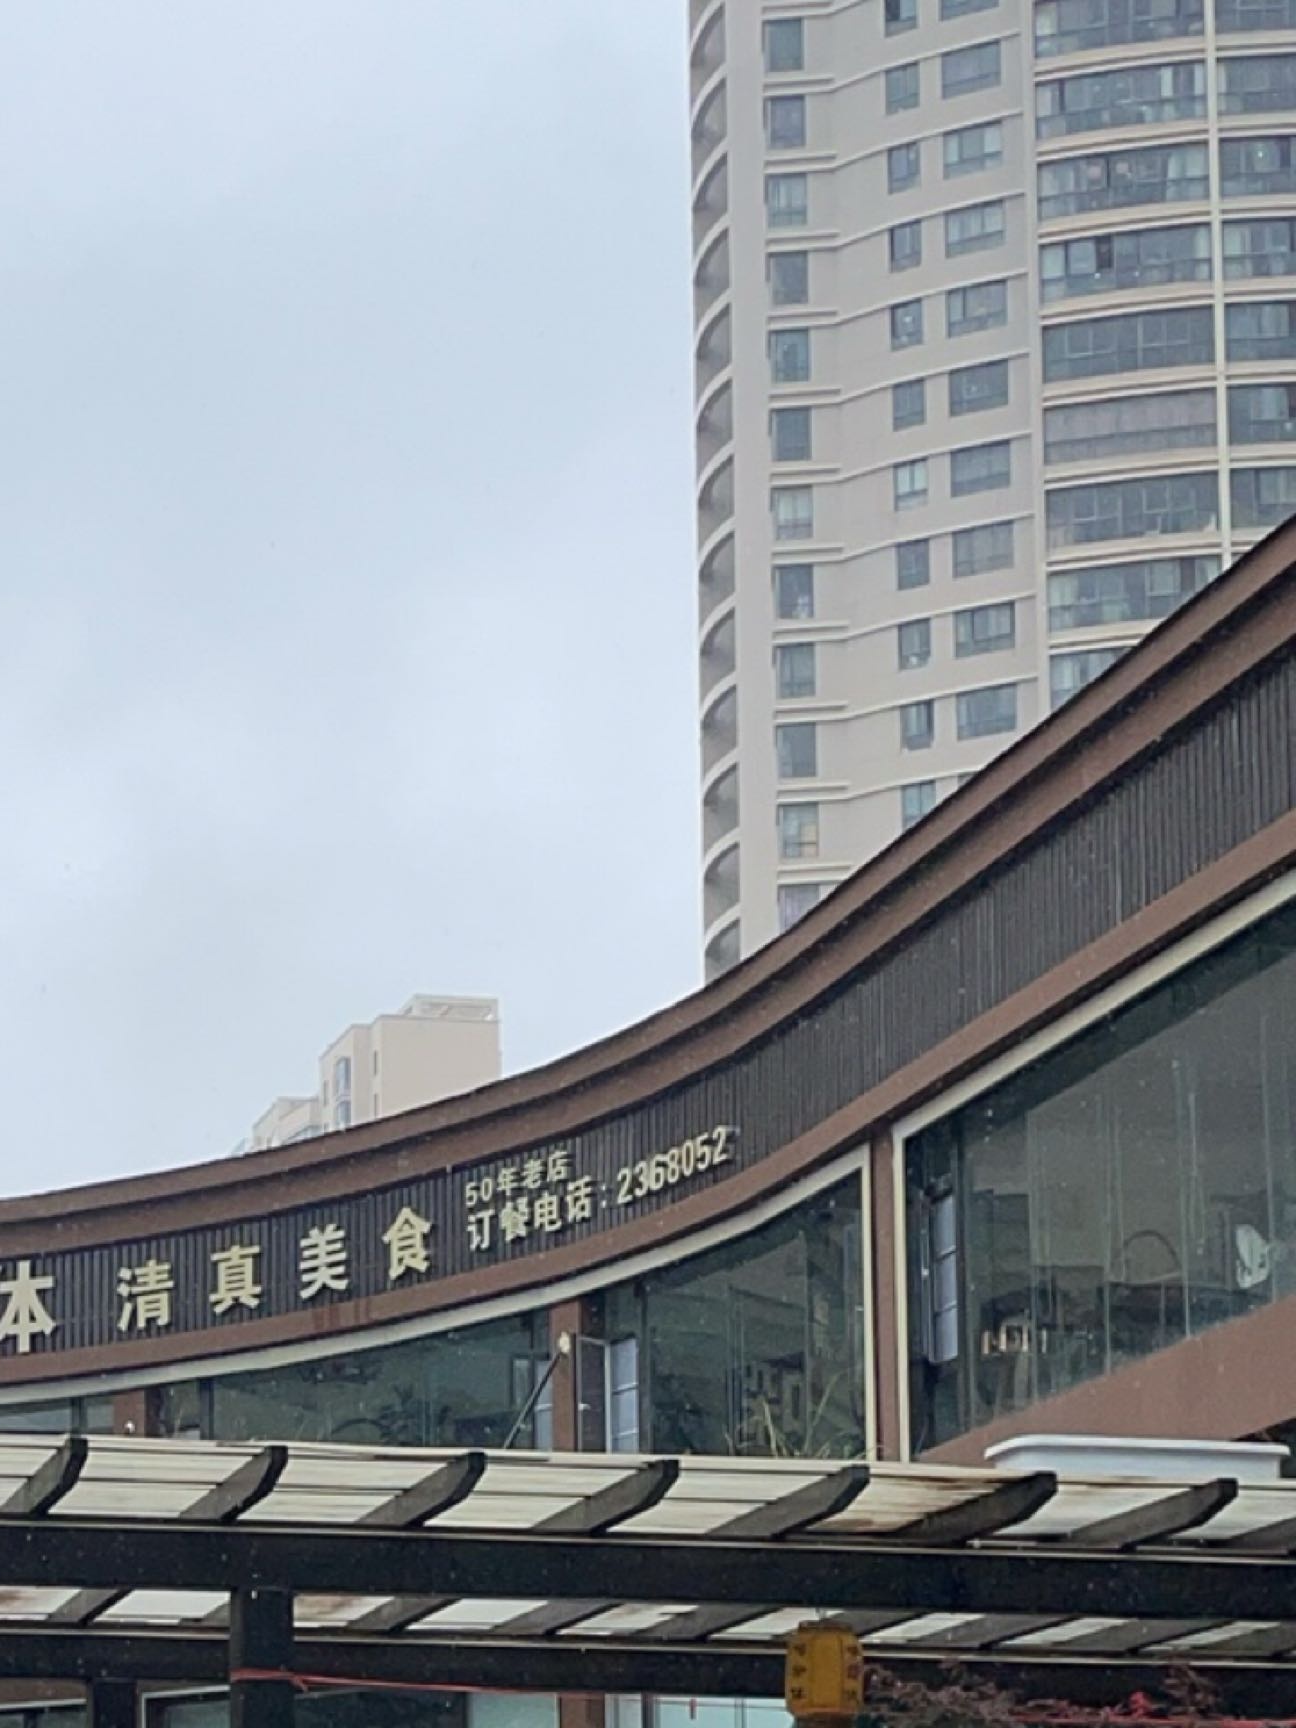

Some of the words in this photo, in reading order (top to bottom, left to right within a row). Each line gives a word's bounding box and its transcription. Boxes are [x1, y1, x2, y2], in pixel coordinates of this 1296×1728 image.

[465, 1150, 571, 1207] 50年老店
[117, 1207, 433, 1332] 清真美食
